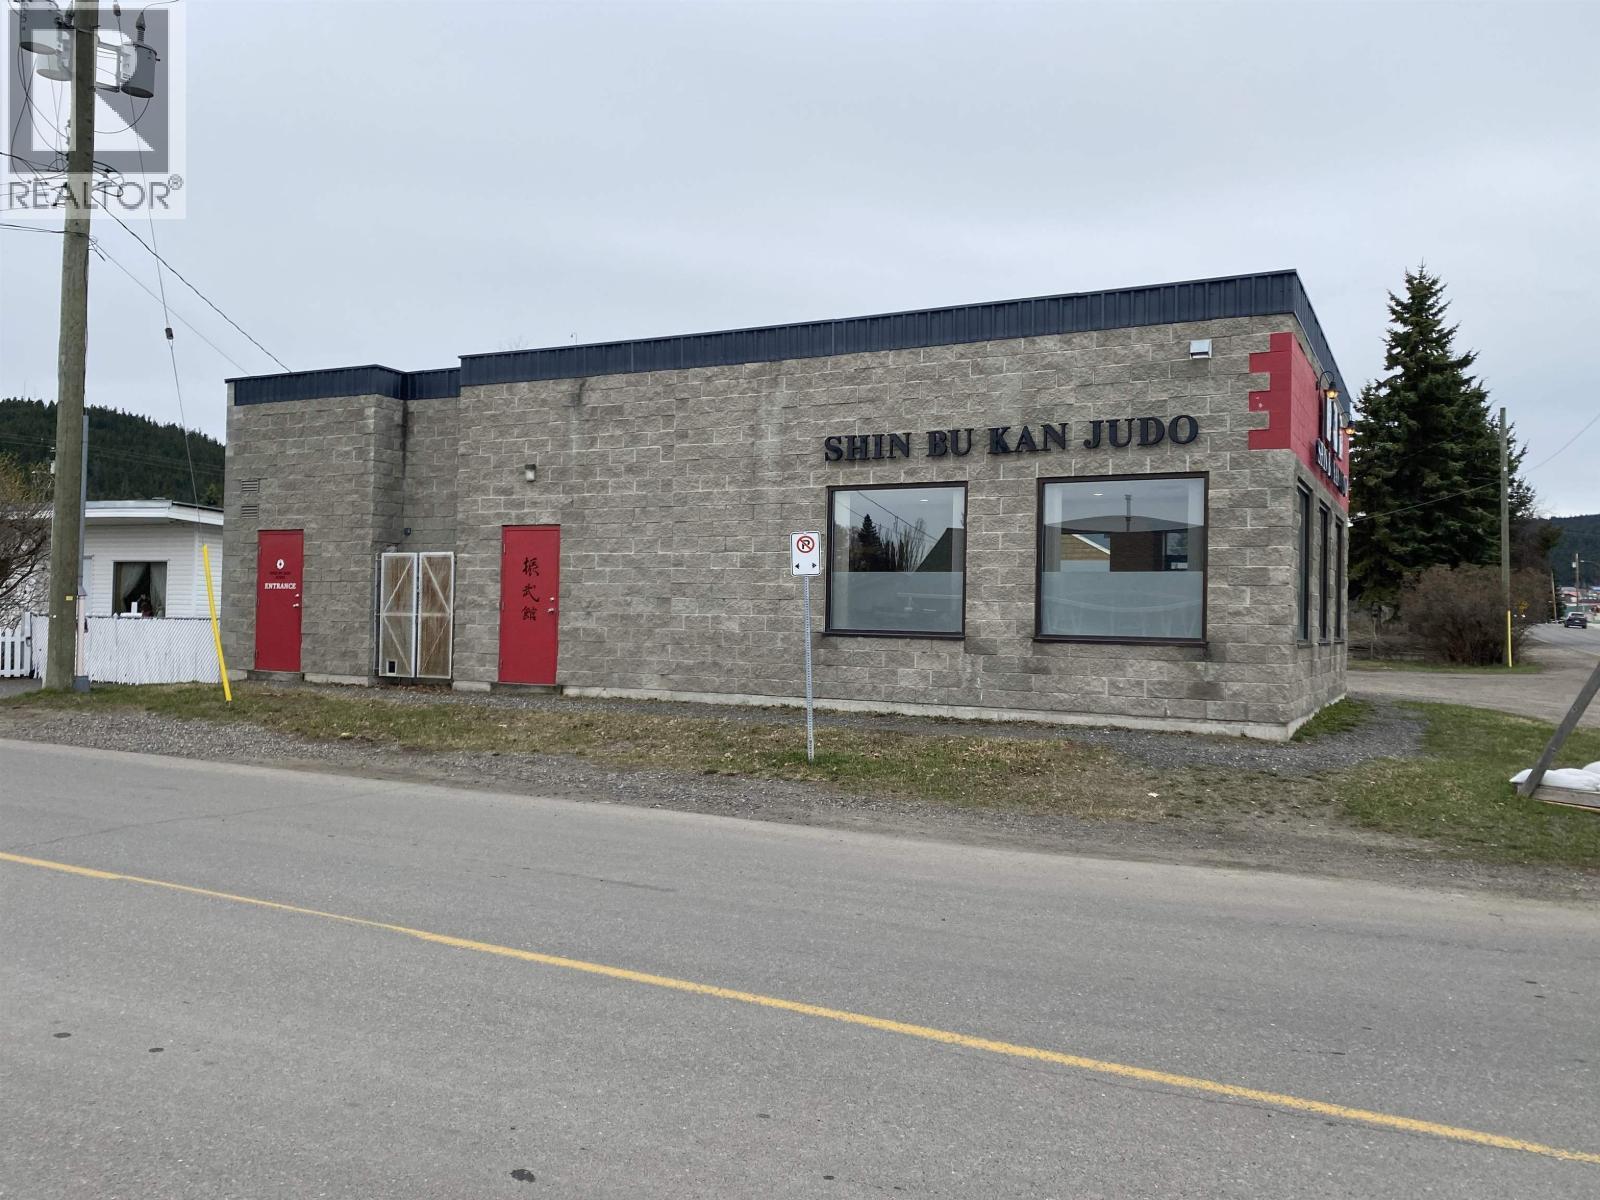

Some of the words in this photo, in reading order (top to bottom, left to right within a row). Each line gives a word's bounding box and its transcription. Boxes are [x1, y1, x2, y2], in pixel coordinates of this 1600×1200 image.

[824, 432, 912, 462] SHIN
[926, 428, 975, 458] BU
[987, 422, 1069, 455] KAN
[1083, 414, 1199, 450] JUDO
[264, 582, 297, 590] ENTRANCE
